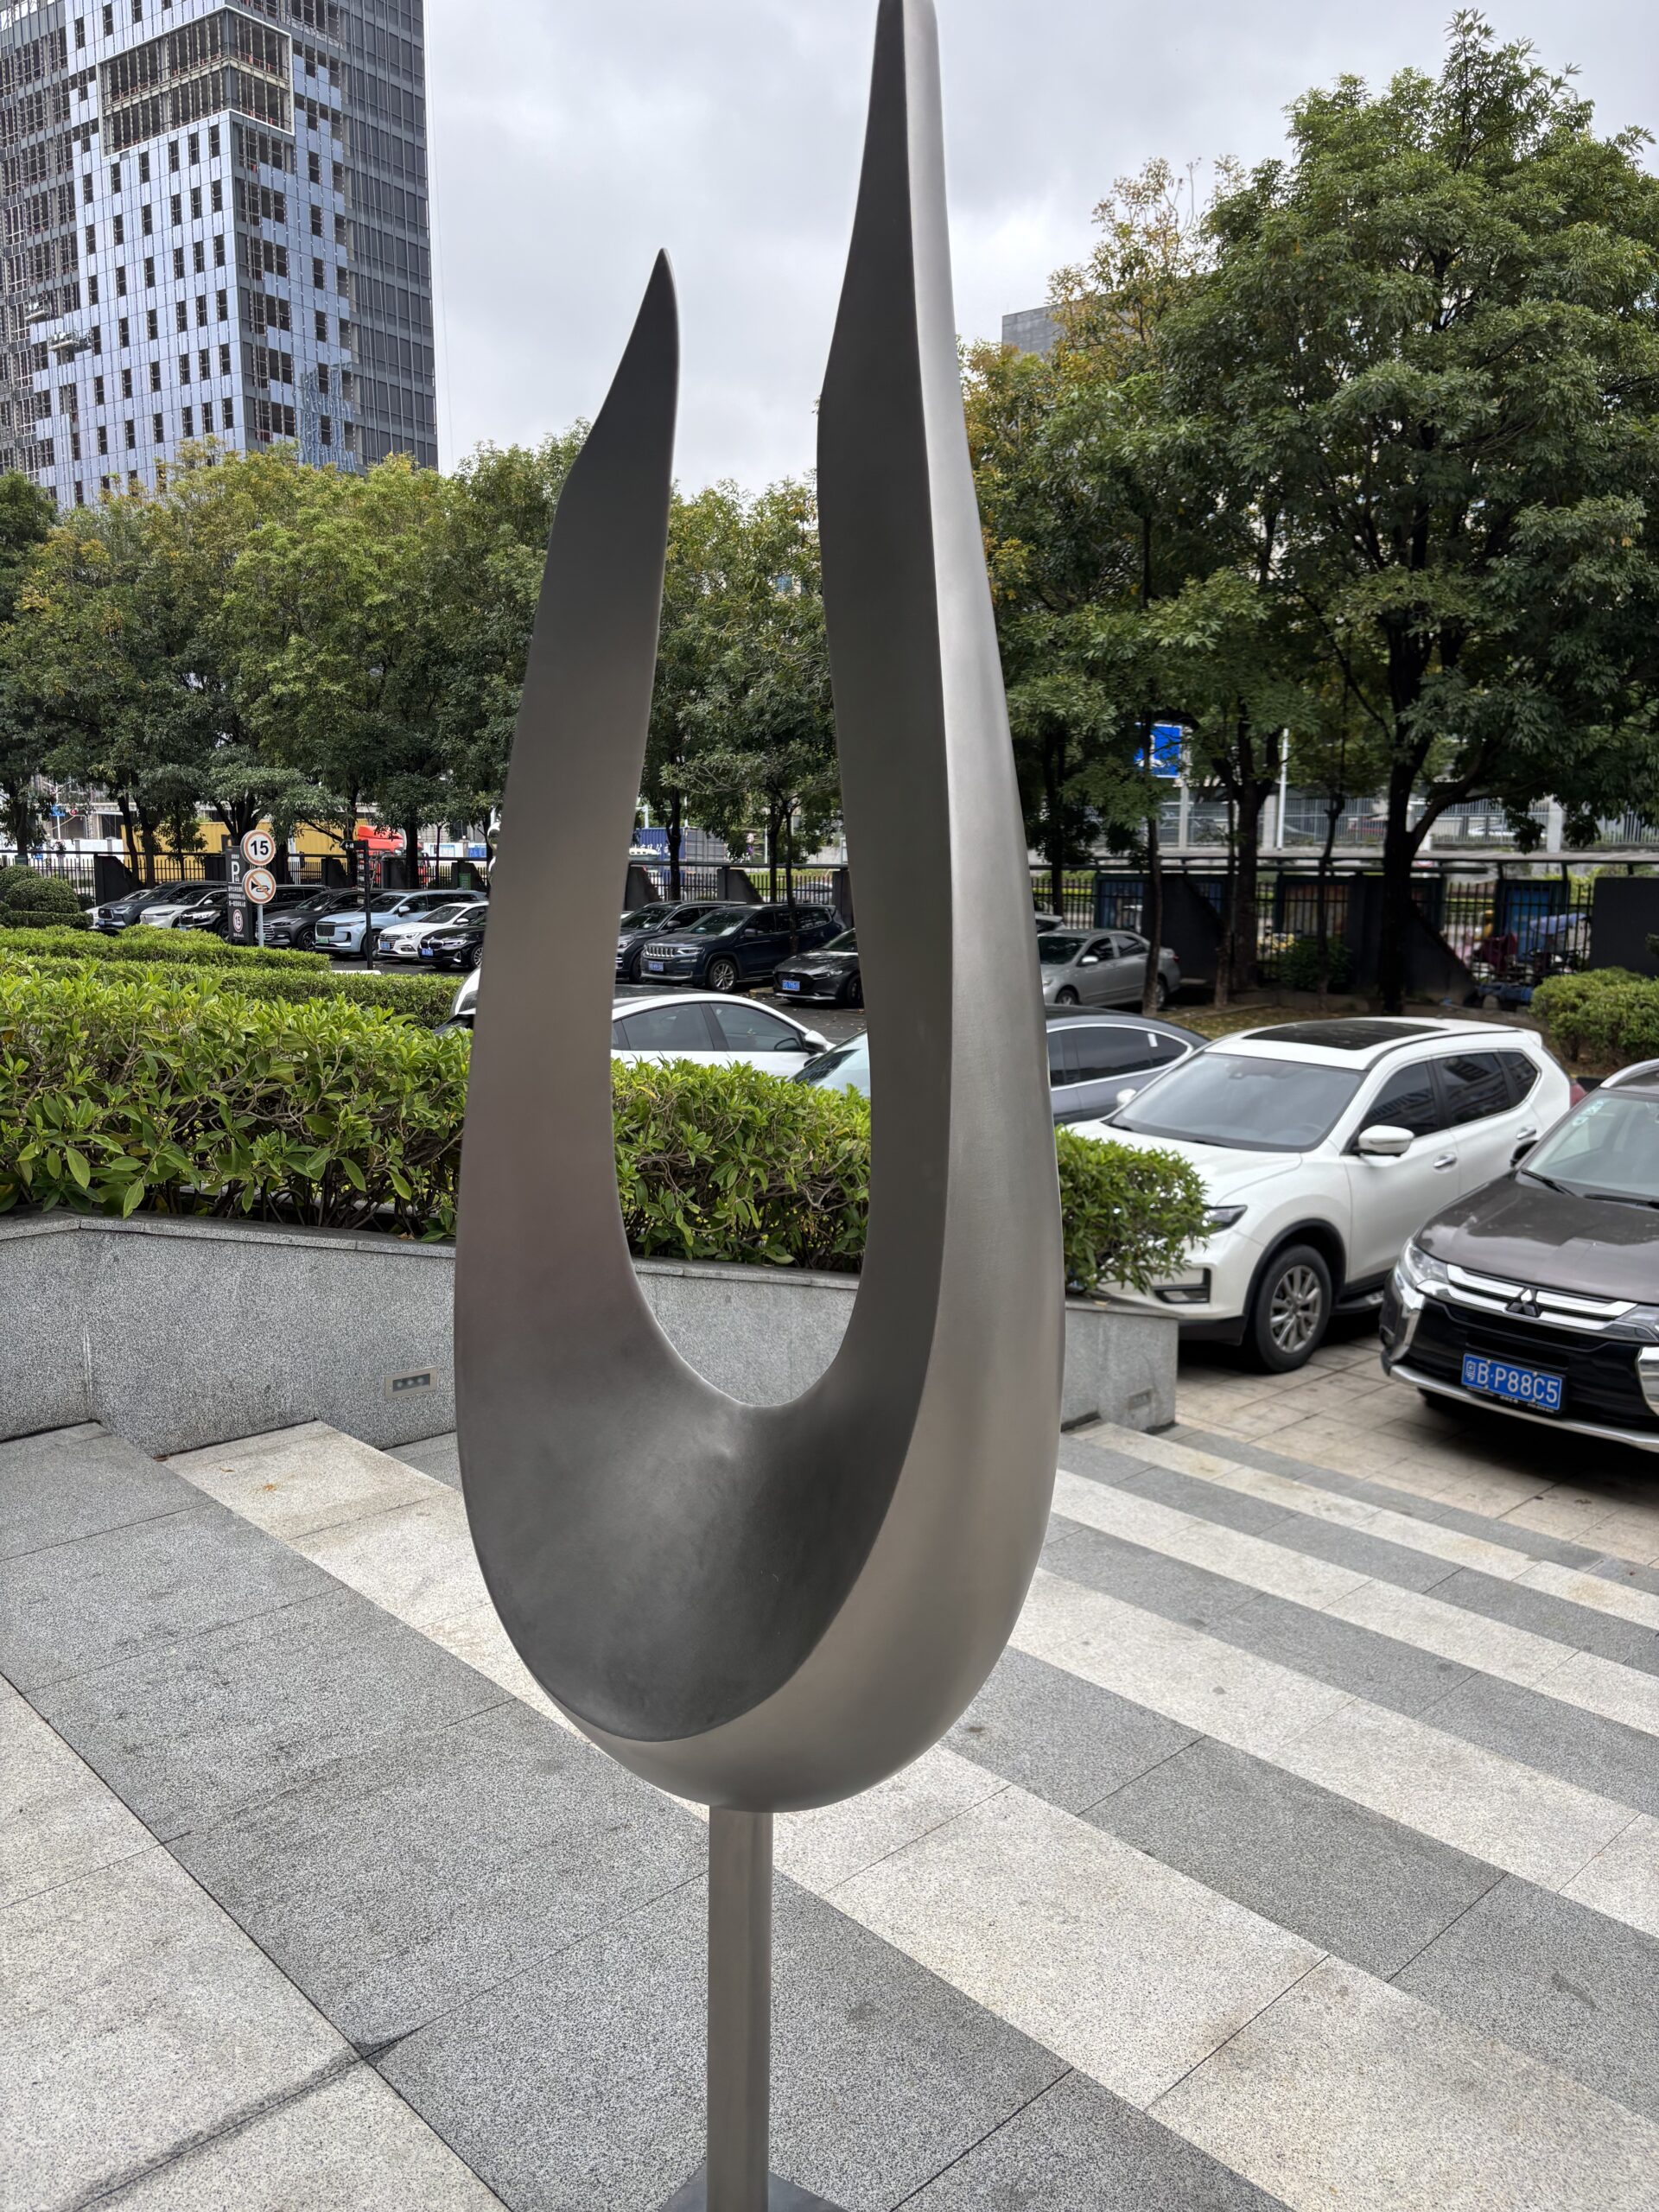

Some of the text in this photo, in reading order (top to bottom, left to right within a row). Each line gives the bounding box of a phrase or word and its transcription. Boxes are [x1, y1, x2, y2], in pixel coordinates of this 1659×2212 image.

[251, 840, 269, 855] 15
[231, 861, 240, 883] P
[235, 916, 241, 926] 15
